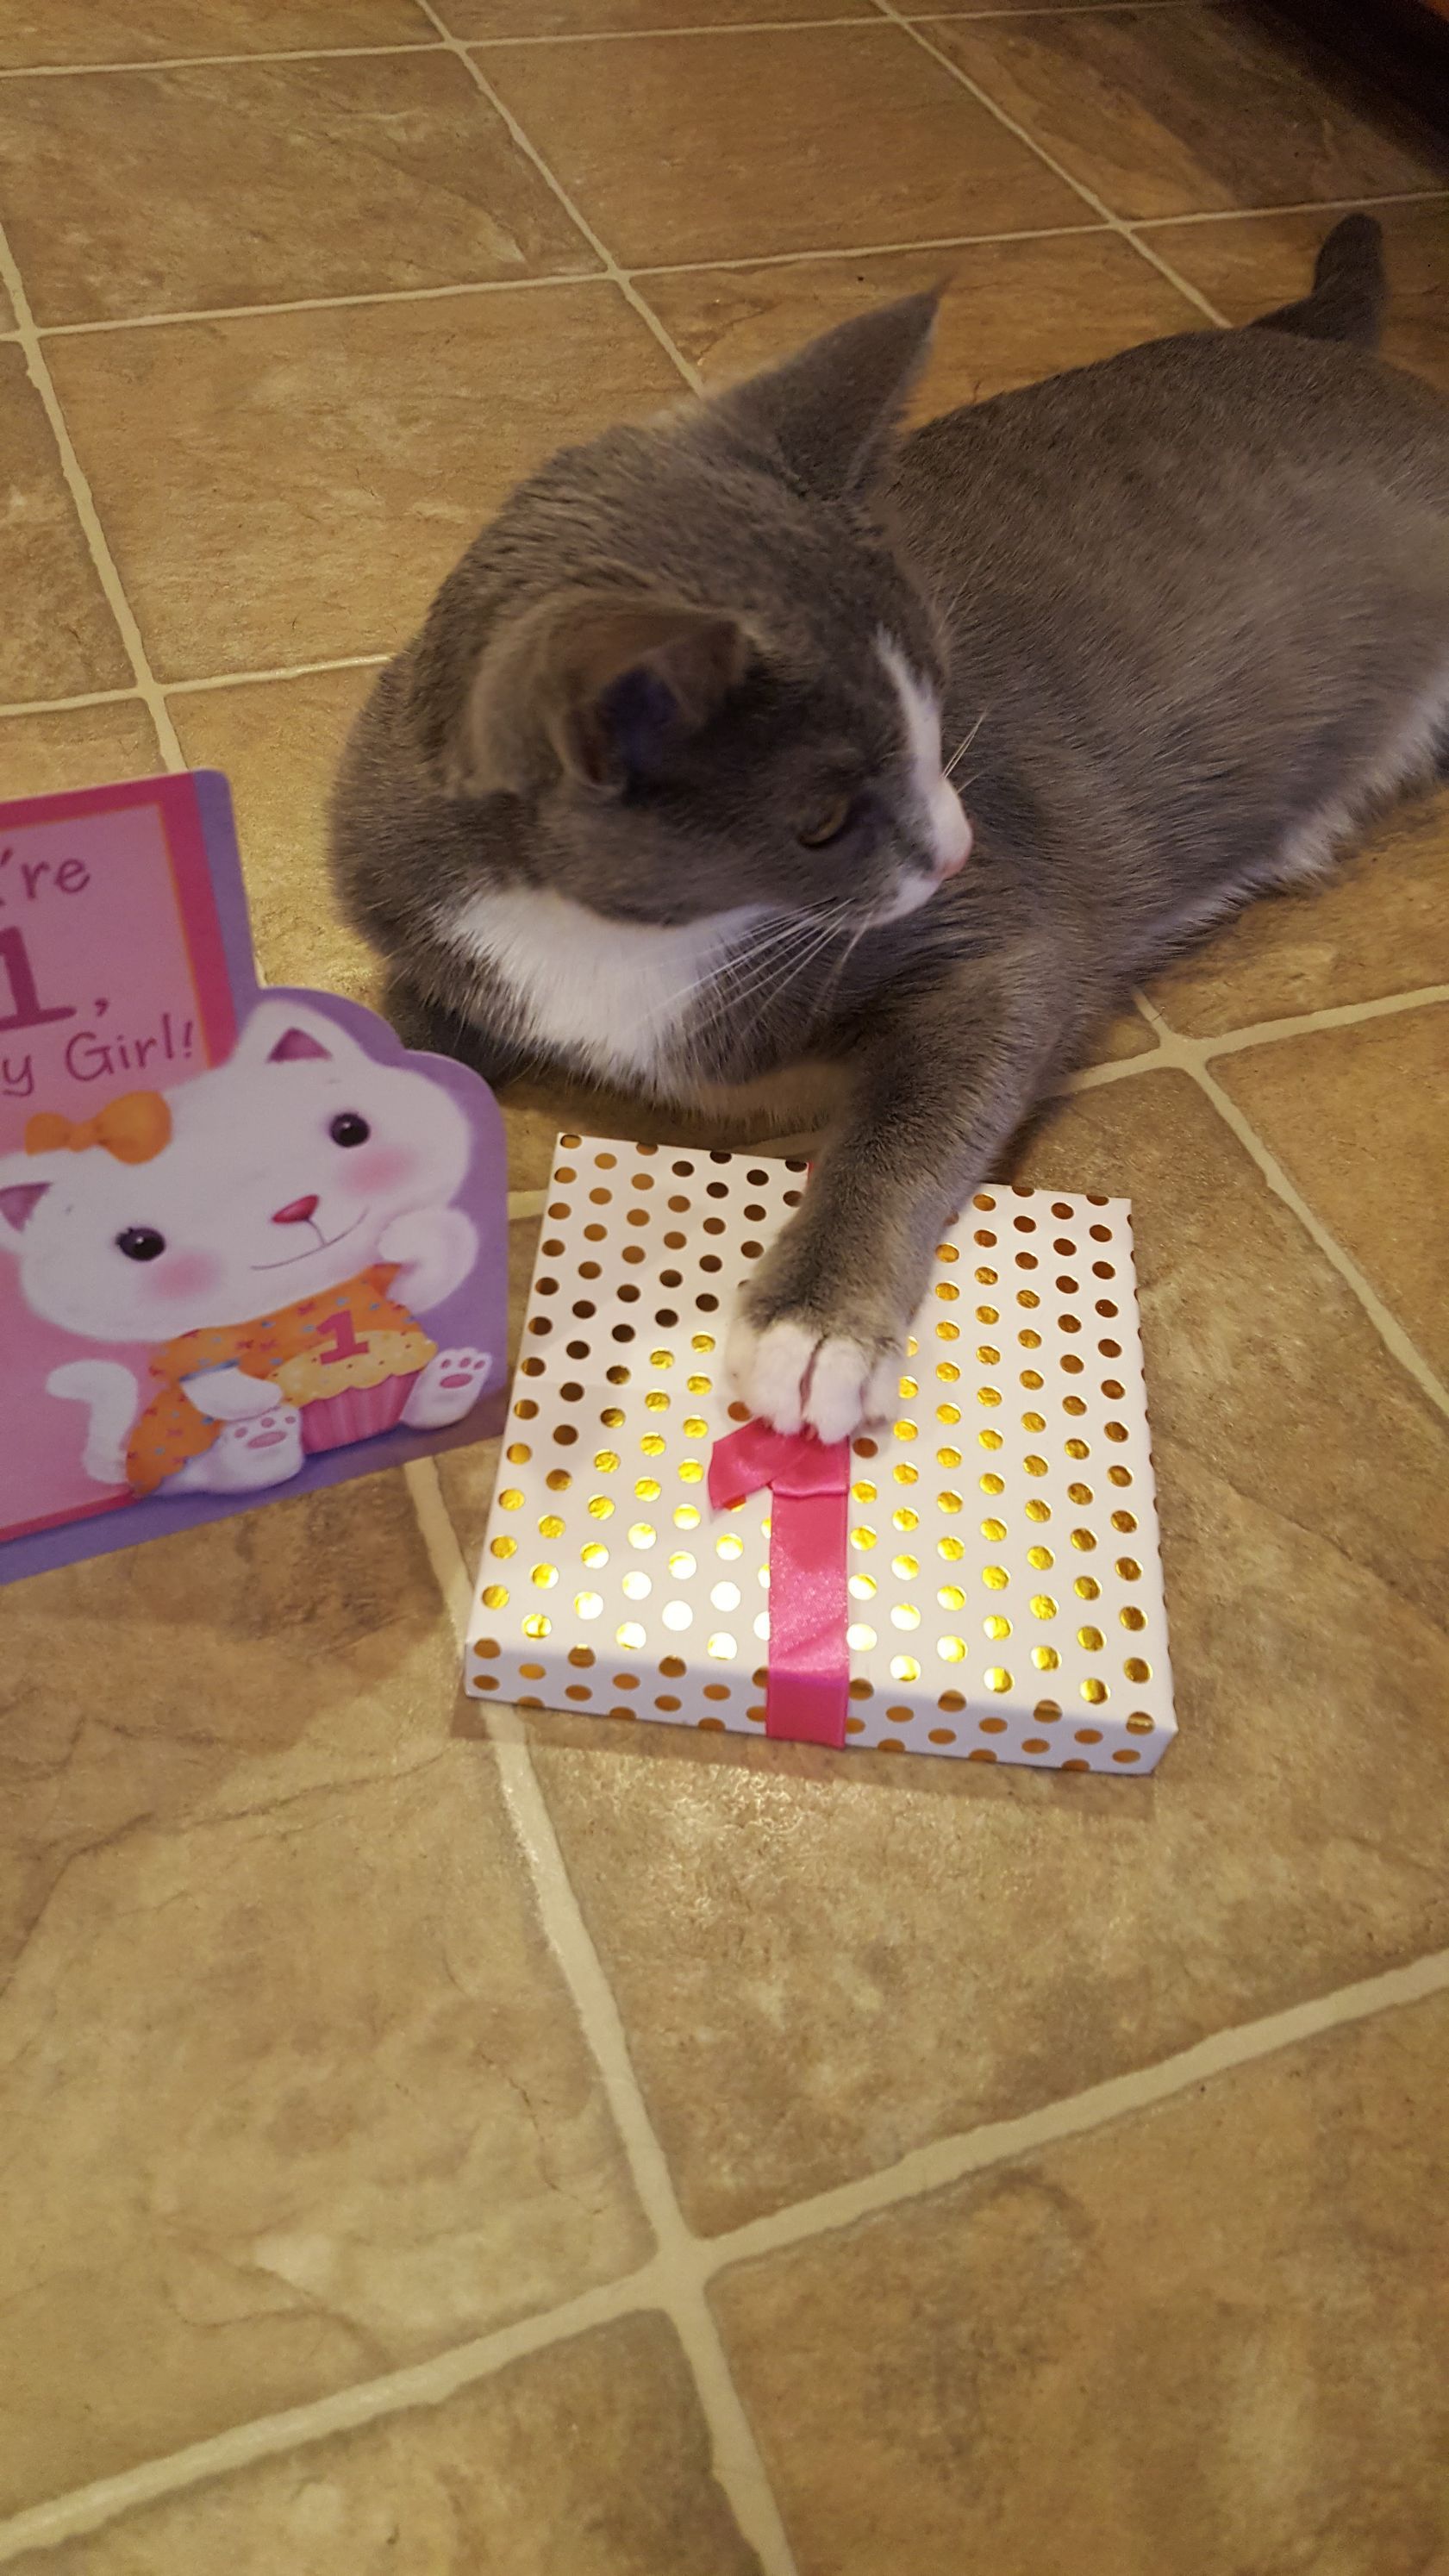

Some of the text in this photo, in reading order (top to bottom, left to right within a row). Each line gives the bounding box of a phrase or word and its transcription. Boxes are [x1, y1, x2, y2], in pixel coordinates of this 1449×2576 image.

[0, 847, 91, 905] 're
[65, 1012, 193, 1081] Girl!
[316, 1310, 370, 1366] 1
